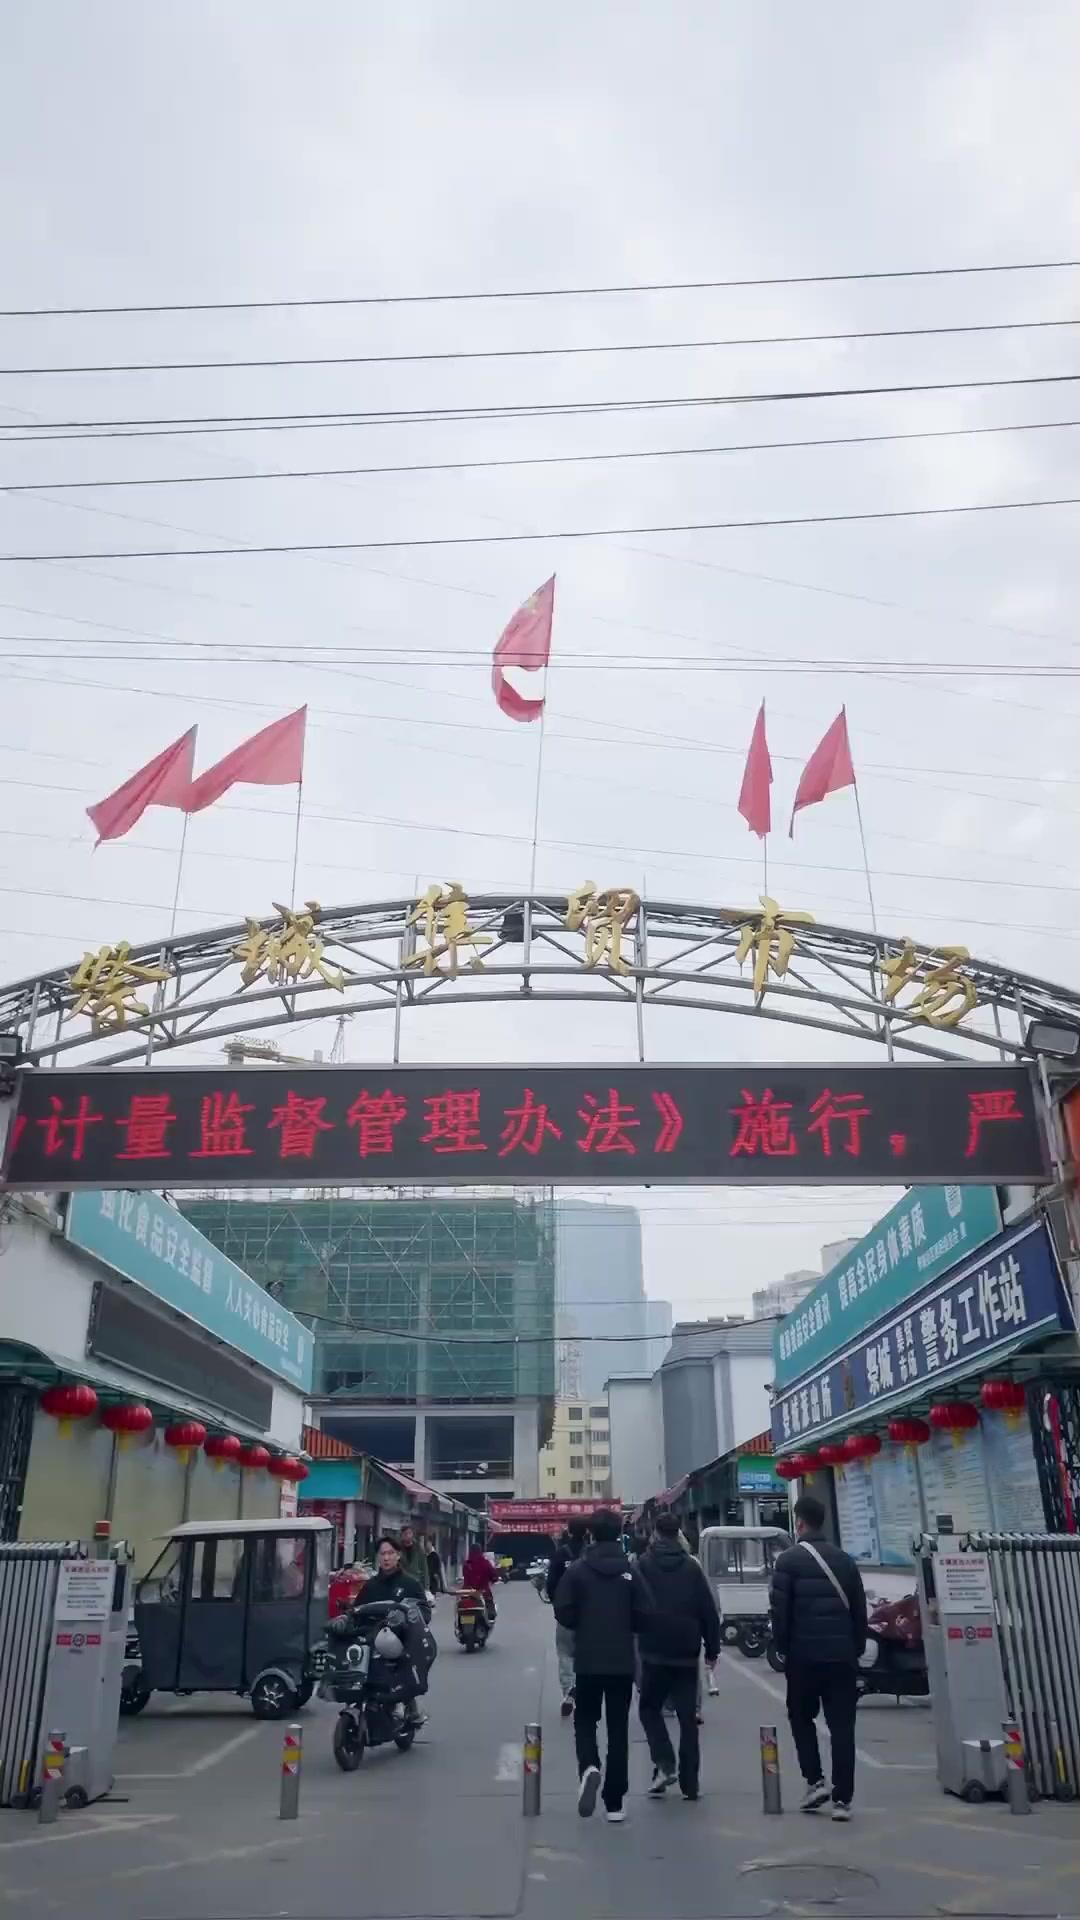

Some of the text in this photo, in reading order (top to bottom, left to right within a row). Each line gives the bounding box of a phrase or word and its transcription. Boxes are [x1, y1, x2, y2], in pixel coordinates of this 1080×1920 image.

[10, 1088, 1024, 1161] 计量监督管理办法》施行，严
